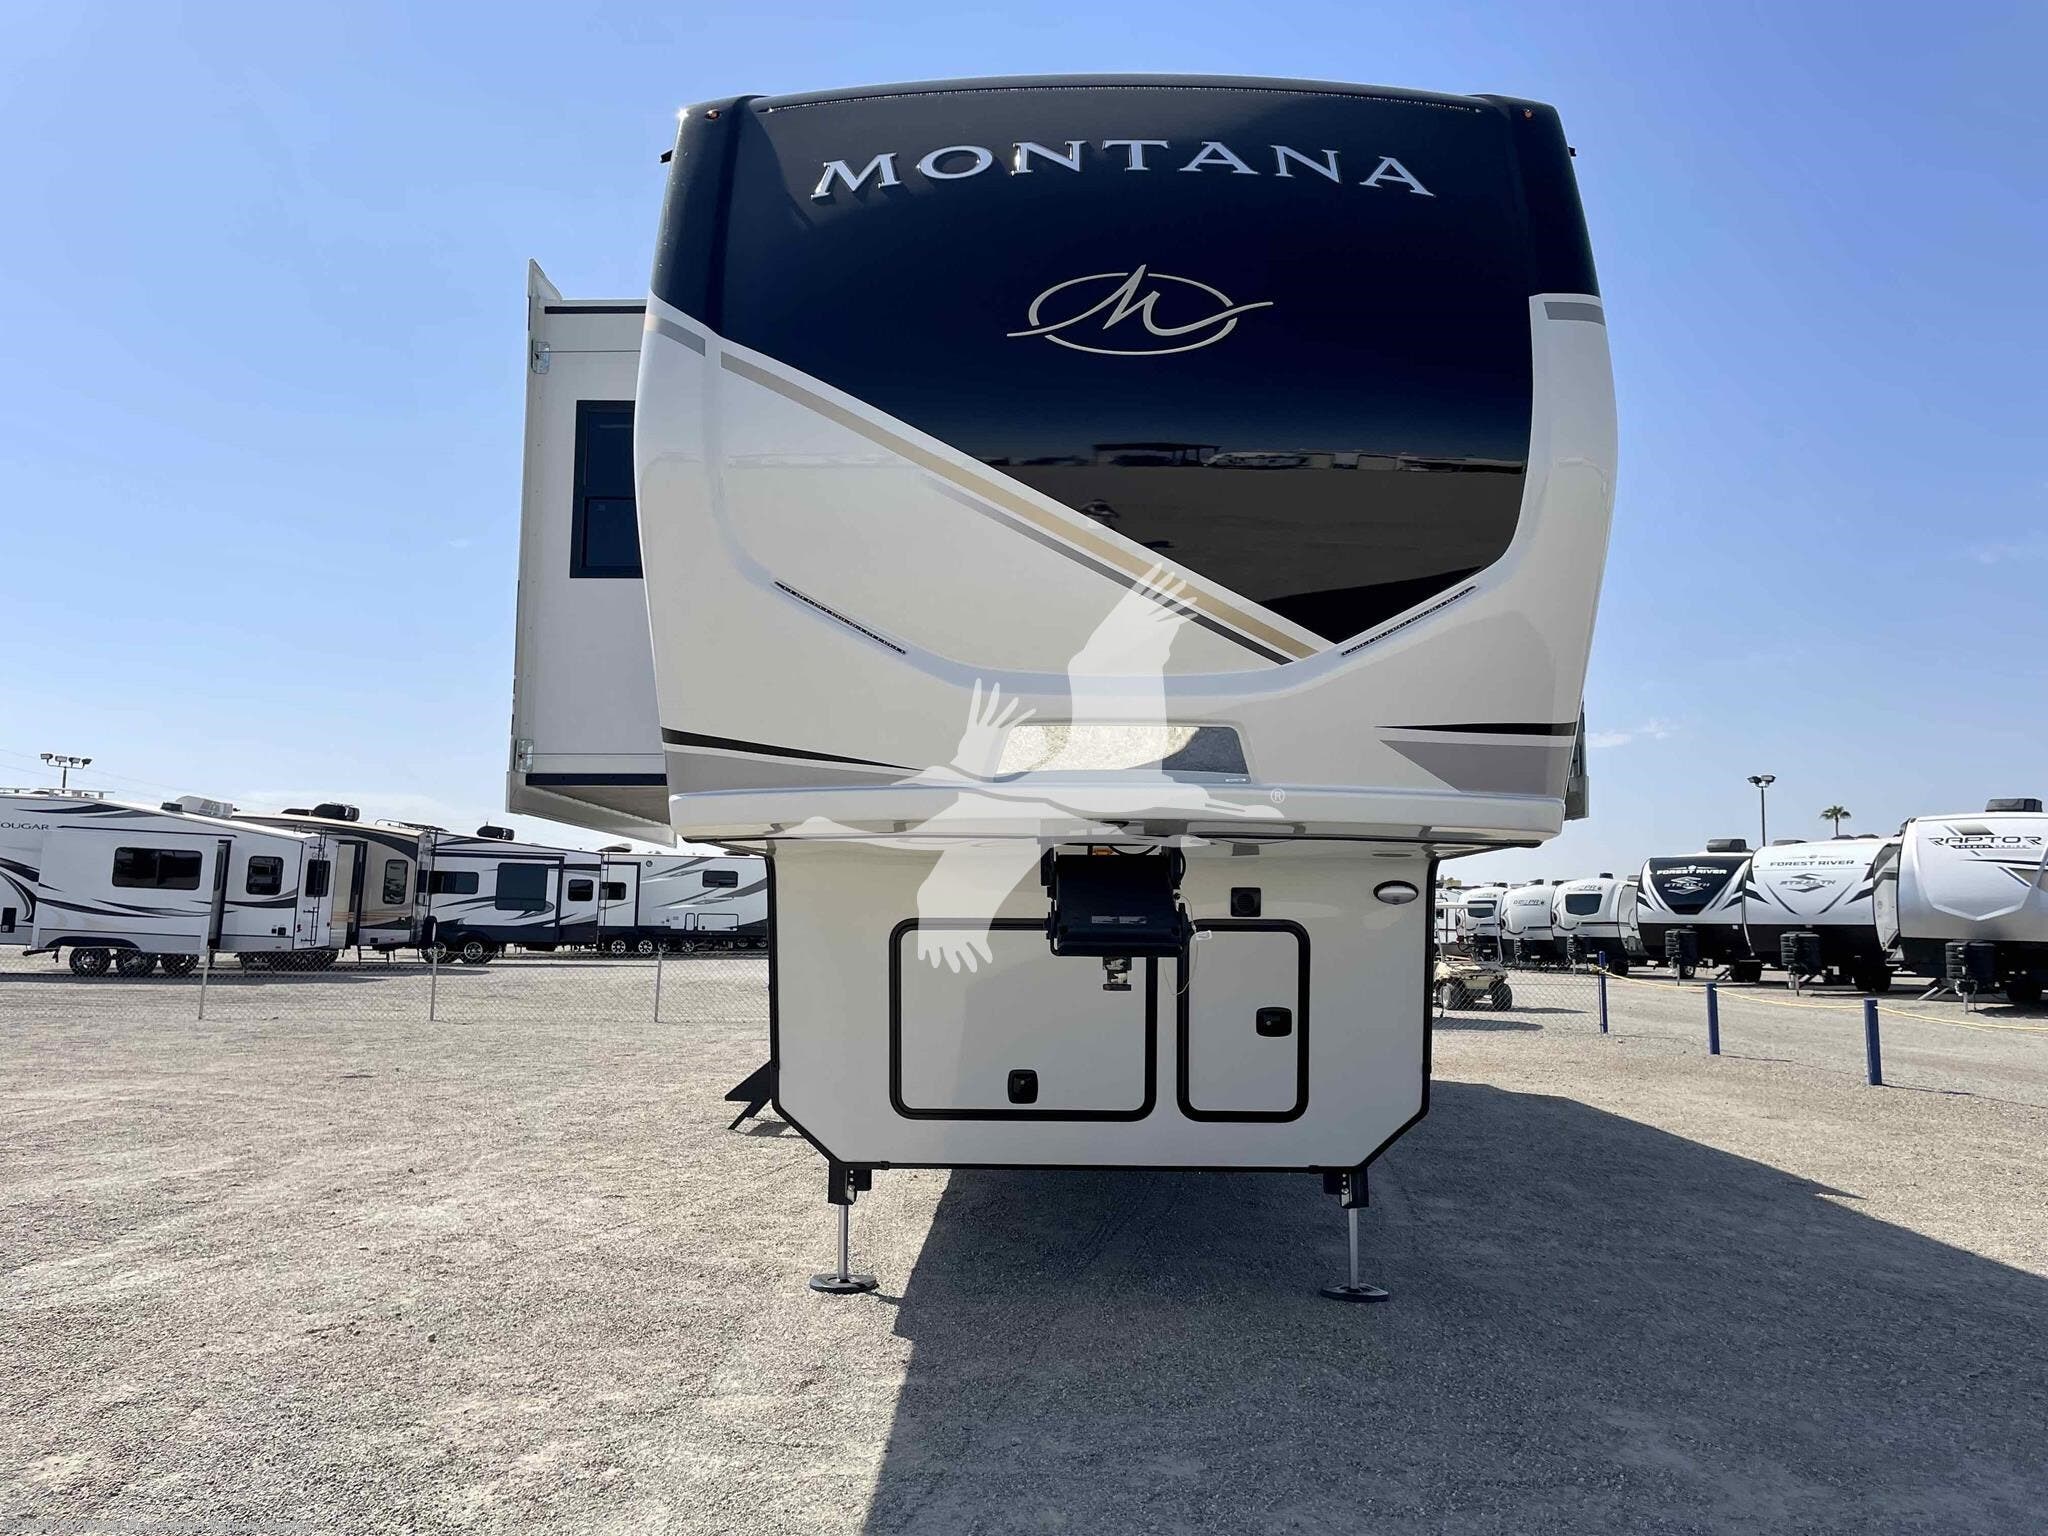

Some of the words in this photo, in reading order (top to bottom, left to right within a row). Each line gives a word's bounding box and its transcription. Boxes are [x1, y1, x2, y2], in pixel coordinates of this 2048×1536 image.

[811, 139, 1435, 198] MONTANA
[0, 822, 49, 830] OUGAR
[1928, 836, 2042, 846] RAPTOR
